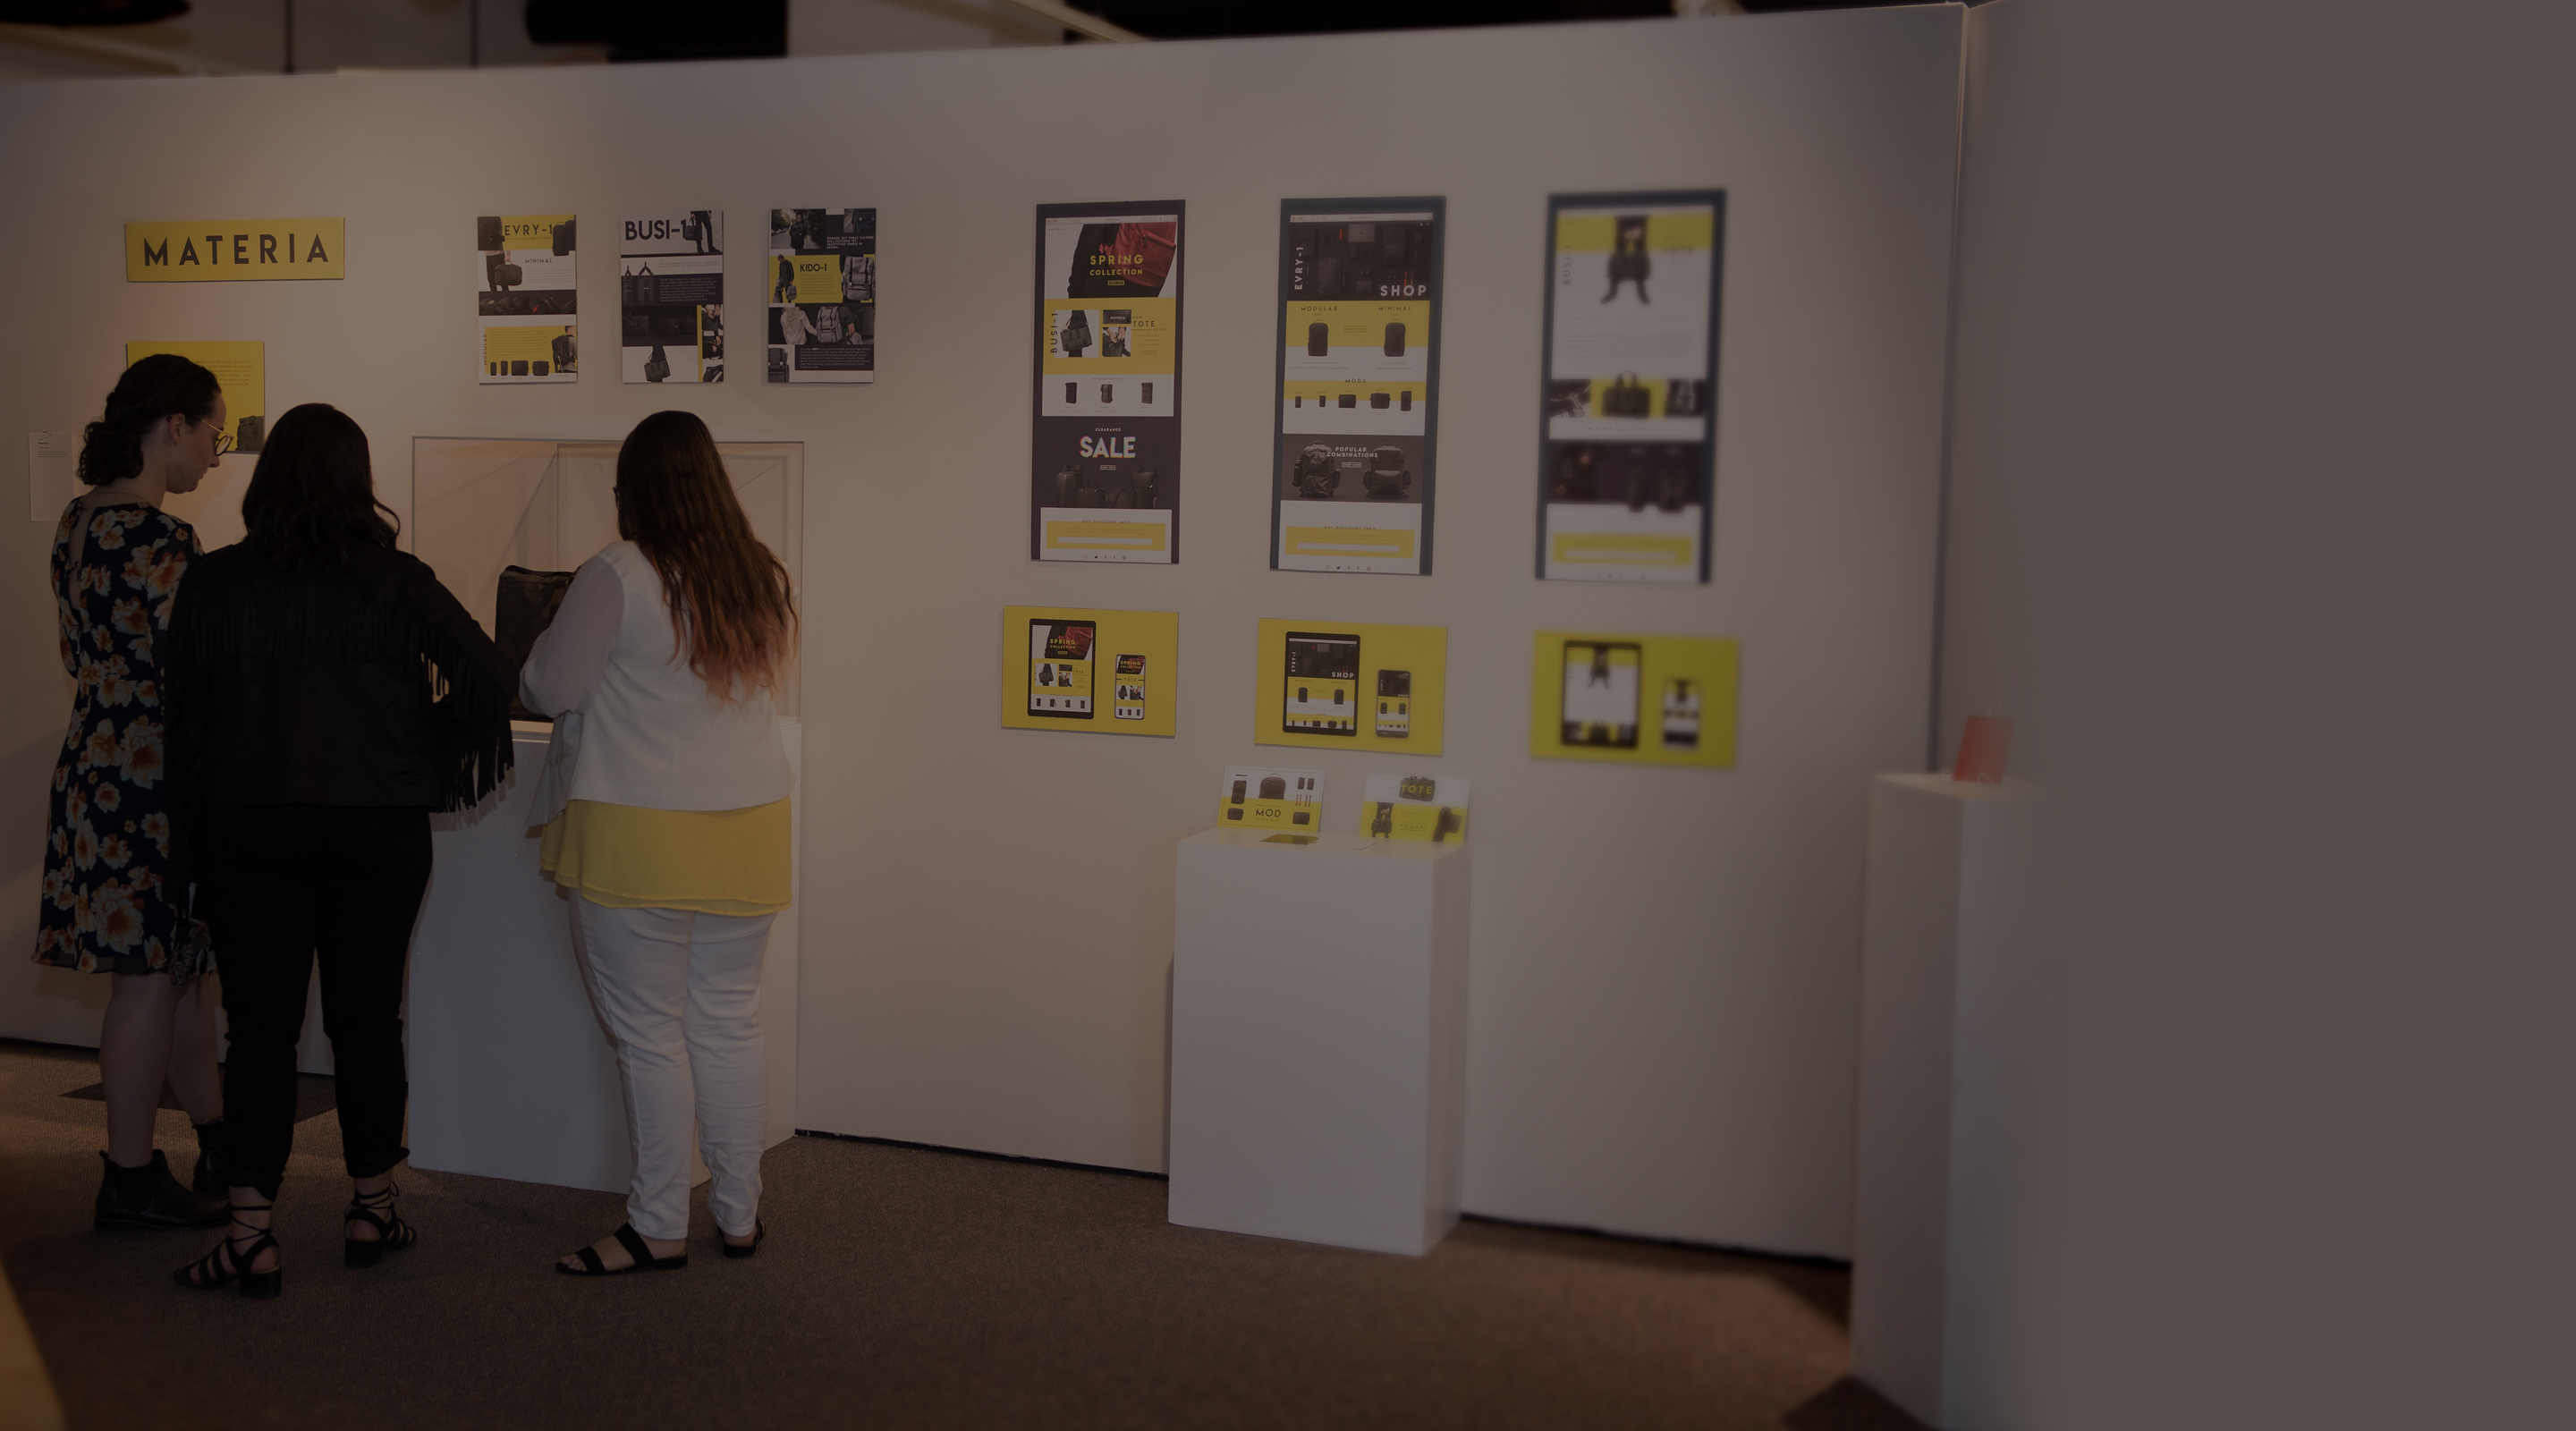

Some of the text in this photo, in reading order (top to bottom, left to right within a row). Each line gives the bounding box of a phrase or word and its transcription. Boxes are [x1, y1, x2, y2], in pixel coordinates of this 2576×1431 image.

[504, 224, 552, 236] EVRY-1
[625, 218, 686, 241] BUSI-1
[143, 233, 329, 267] MATERIA
[1663, 246, 1694, 255] TOTE
[1089, 254, 1144, 266] SPRING
[1563, 245, 1572, 285] BUSI-1
[800, 263, 827, 272] KIDO-1
[1089, 268, 1143, 276] COLLECTION
[1294, 247, 1304, 291] EVRY-1
[1380, 284, 1427, 297] SHOP
[1050, 313, 1058, 353] BUSI-1
[1079, 435, 1136, 459] SALE
[1331, 671, 1354, 679] SHOP
[1401, 783, 1433, 795] TOTE
[1255, 808, 1282, 817] MOD
[1400, 823, 1427, 831] TODAY!
